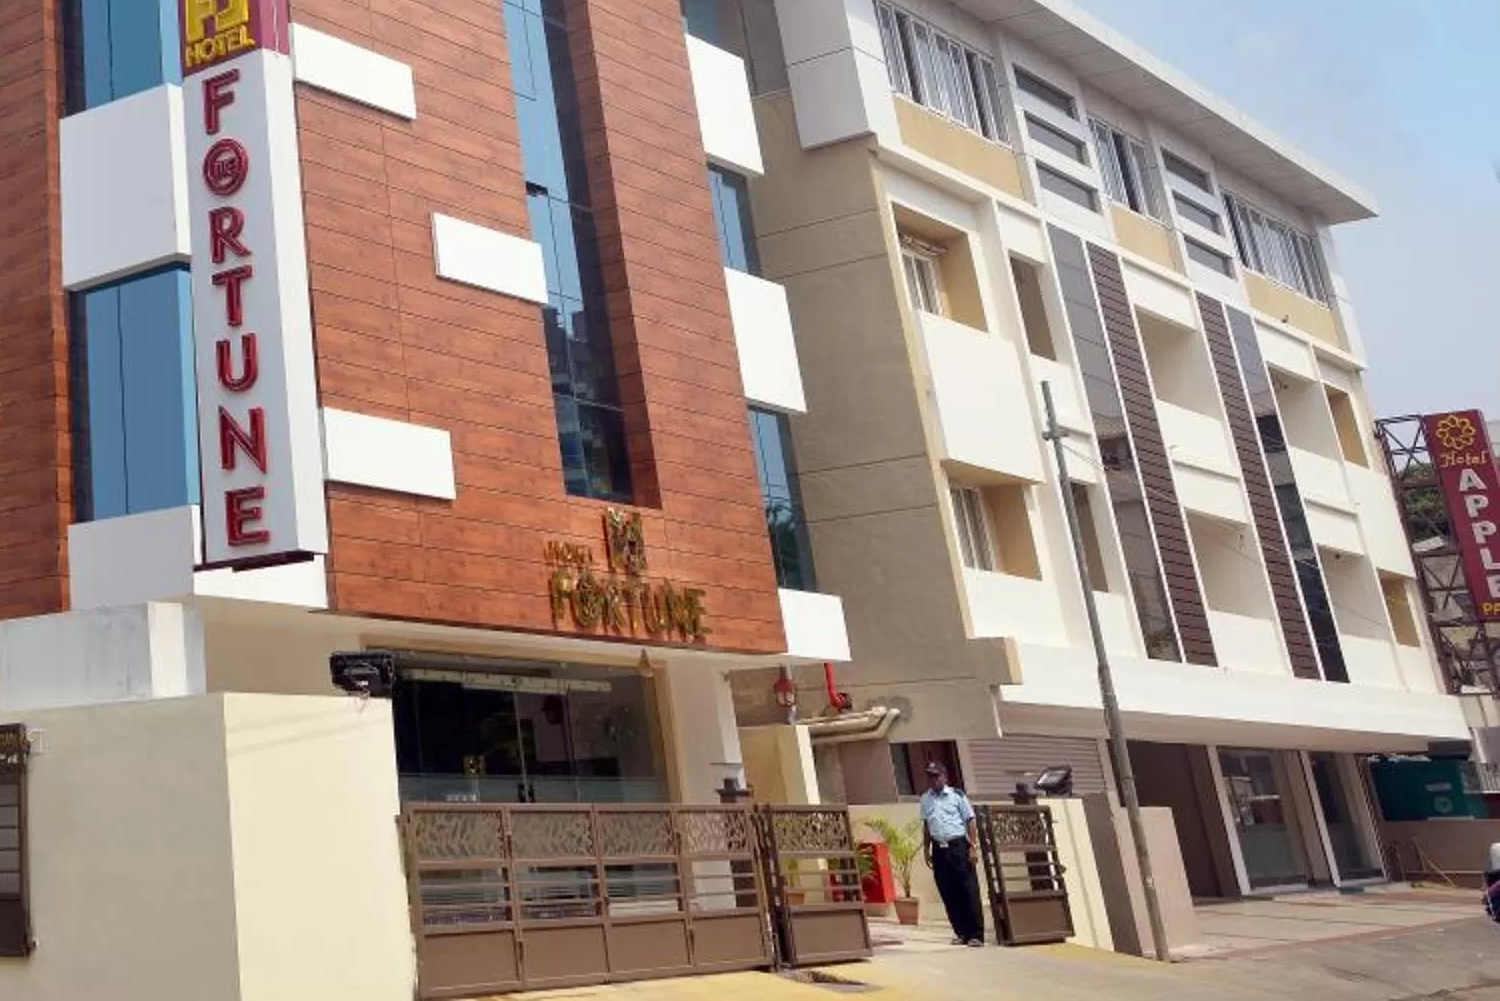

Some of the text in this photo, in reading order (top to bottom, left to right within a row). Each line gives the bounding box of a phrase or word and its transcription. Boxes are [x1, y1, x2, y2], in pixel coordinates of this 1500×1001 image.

[185, 24, 256, 68] HOTEL
[202, 68, 270, 546] FORTUNE
[1440, 450, 1488, 468] Hotel
[549, 567, 712, 639] FORTUNE
